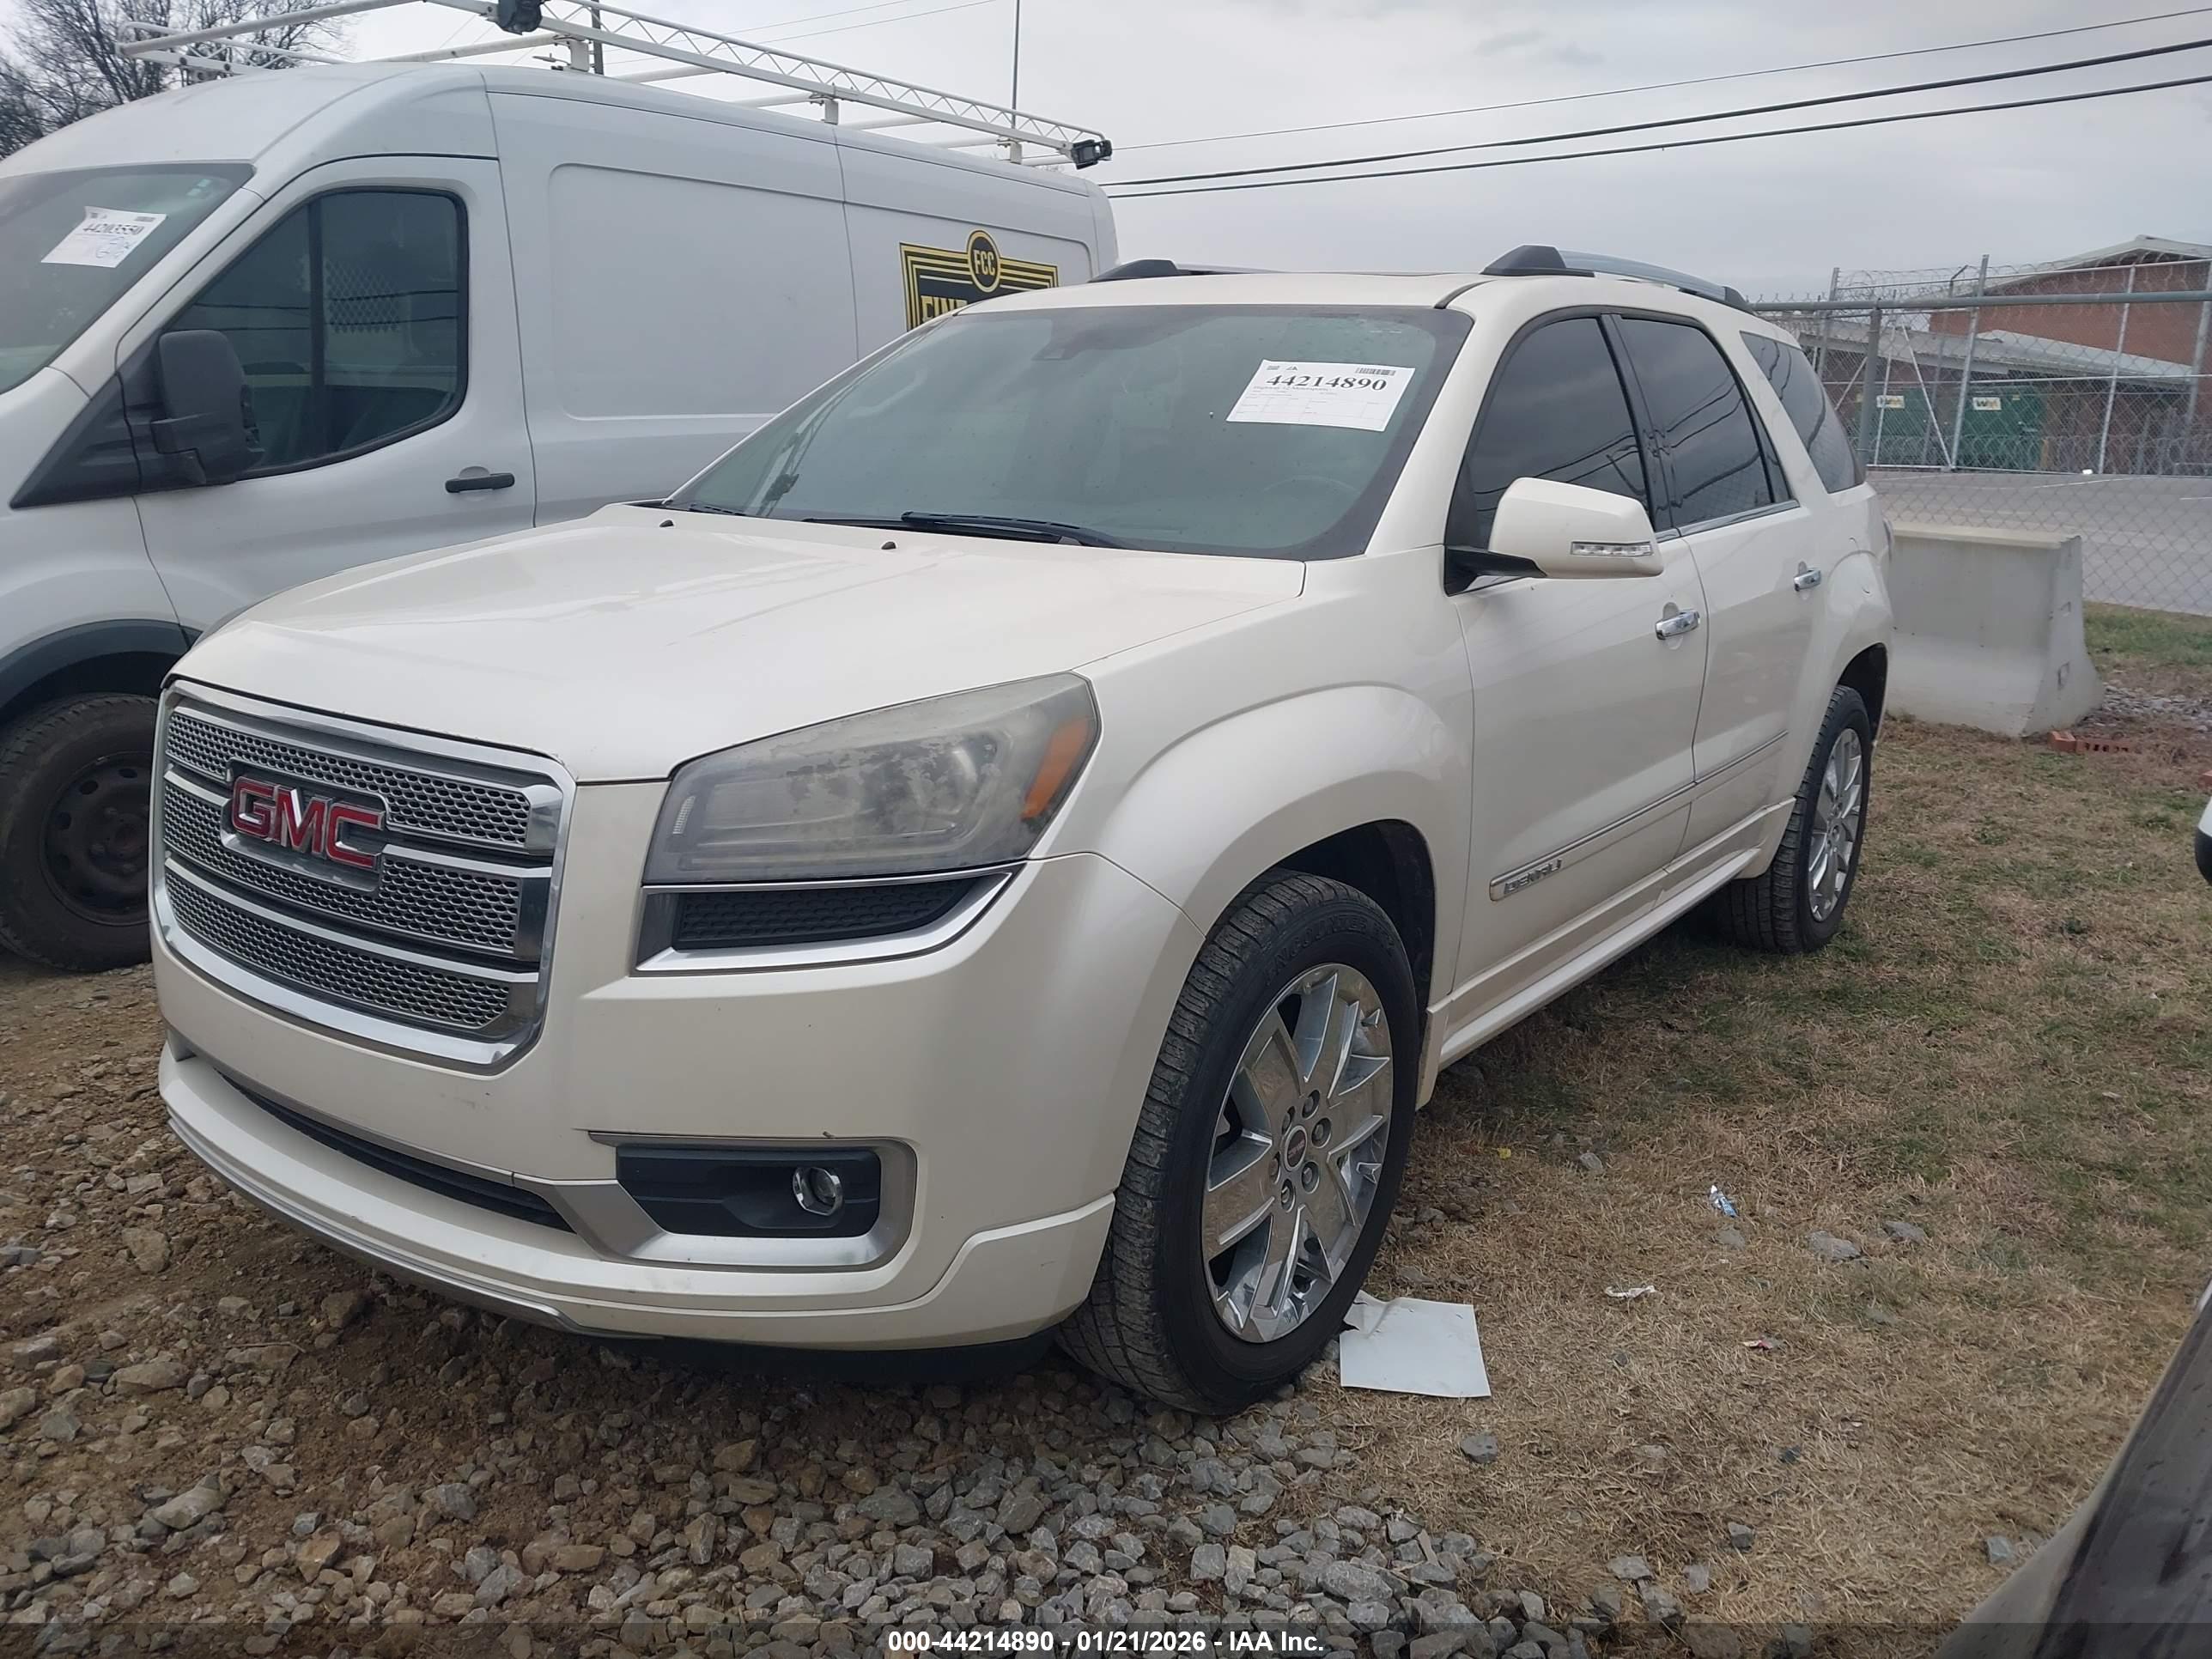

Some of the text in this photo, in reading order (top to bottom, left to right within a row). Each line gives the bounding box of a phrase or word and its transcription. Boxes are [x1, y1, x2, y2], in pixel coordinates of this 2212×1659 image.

[973, 249, 995, 276] FCC
[1266, 374, 1388, 391] 44214890
[232, 776, 386, 872] GMC
